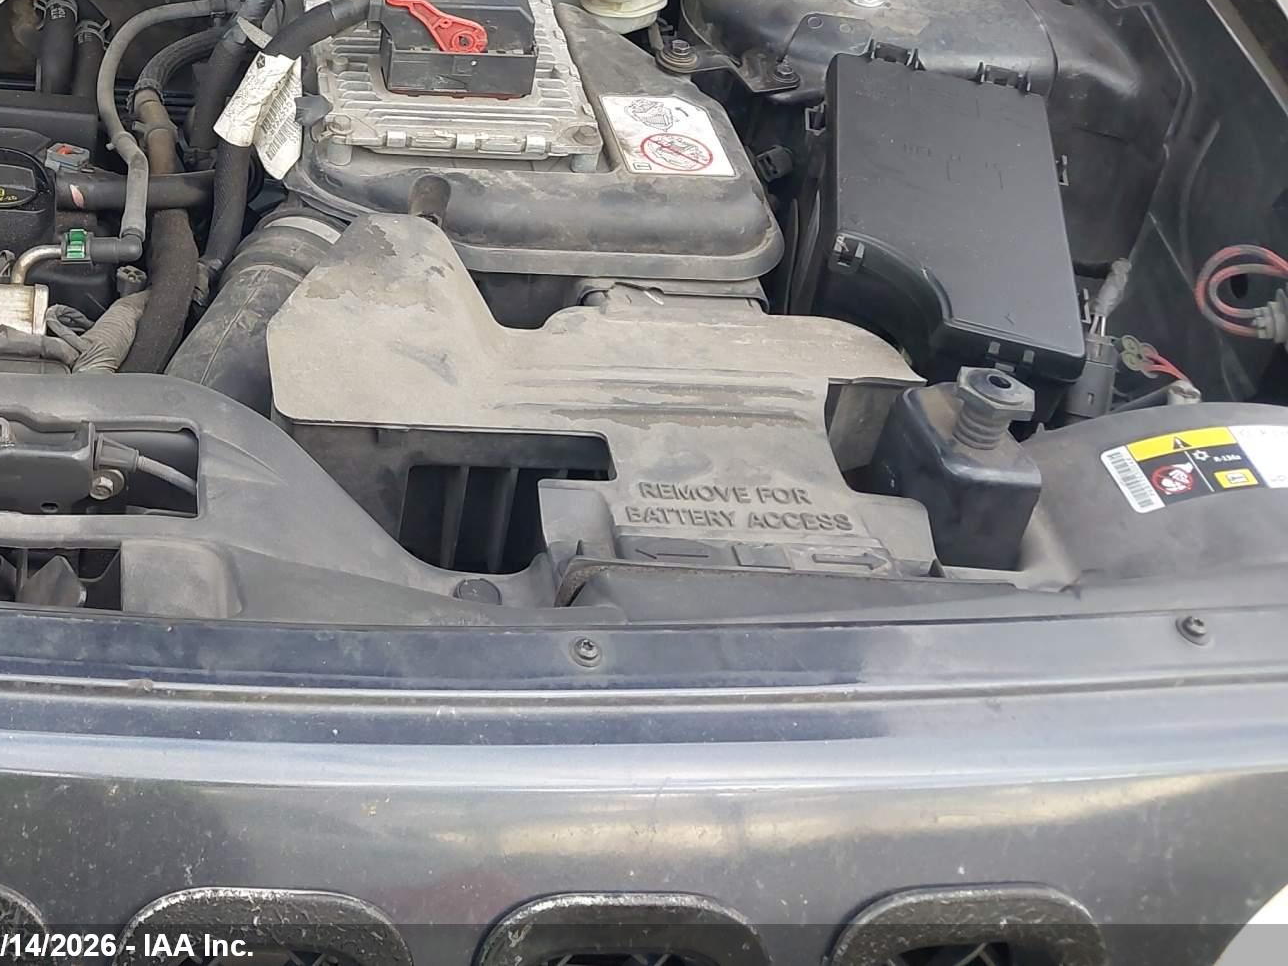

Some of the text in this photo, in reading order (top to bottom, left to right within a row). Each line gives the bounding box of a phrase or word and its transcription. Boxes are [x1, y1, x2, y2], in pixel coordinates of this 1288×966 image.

[638, 480, 813, 505] REMOVE FOR
[624, 505, 854, 532] BATTERY ACCESS
